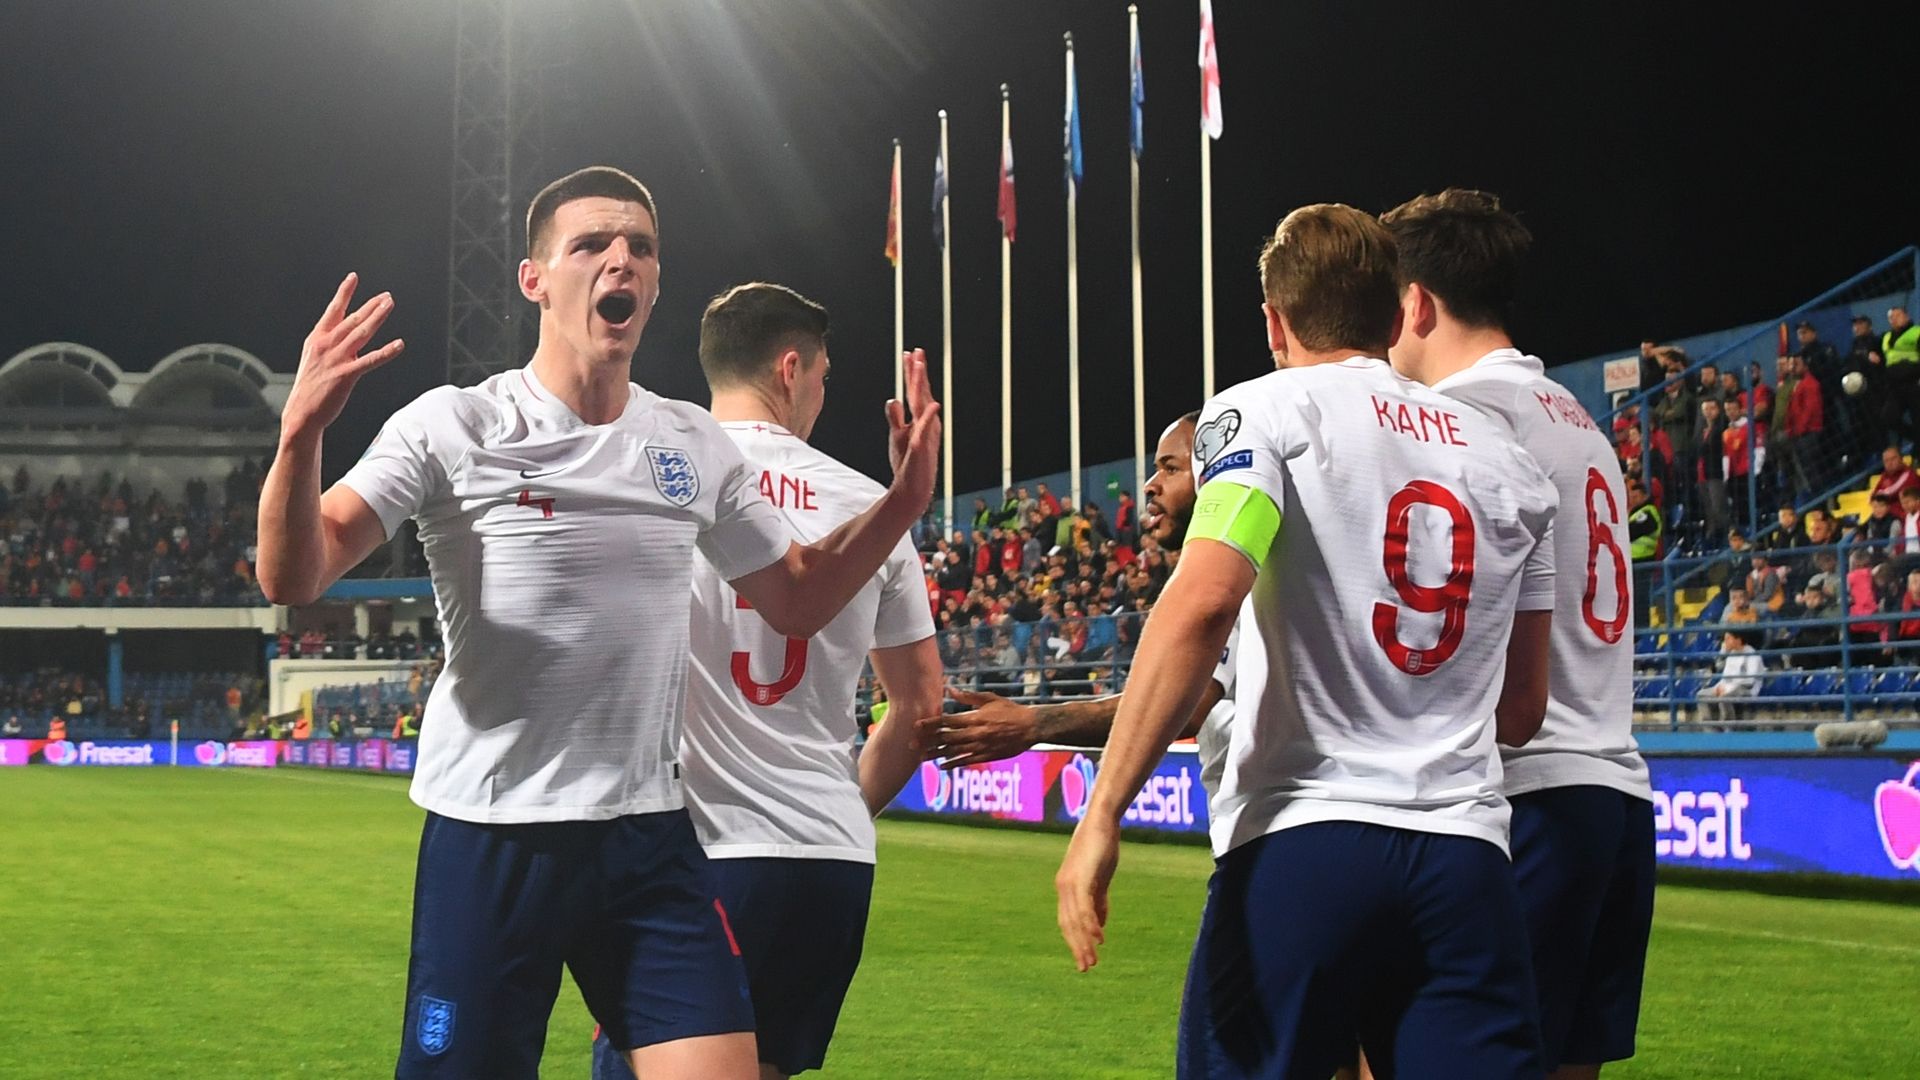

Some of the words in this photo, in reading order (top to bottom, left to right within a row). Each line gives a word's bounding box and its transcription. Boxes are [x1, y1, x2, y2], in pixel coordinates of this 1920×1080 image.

[1371, 395, 1467, 447] KANE
[1372, 479, 1475, 677] 9
[1582, 466, 1630, 645] 6
[79, 740, 153, 765] Freesat
[952, 762, 1023, 812] Freesat
[1653, 777, 1752, 861] esat
